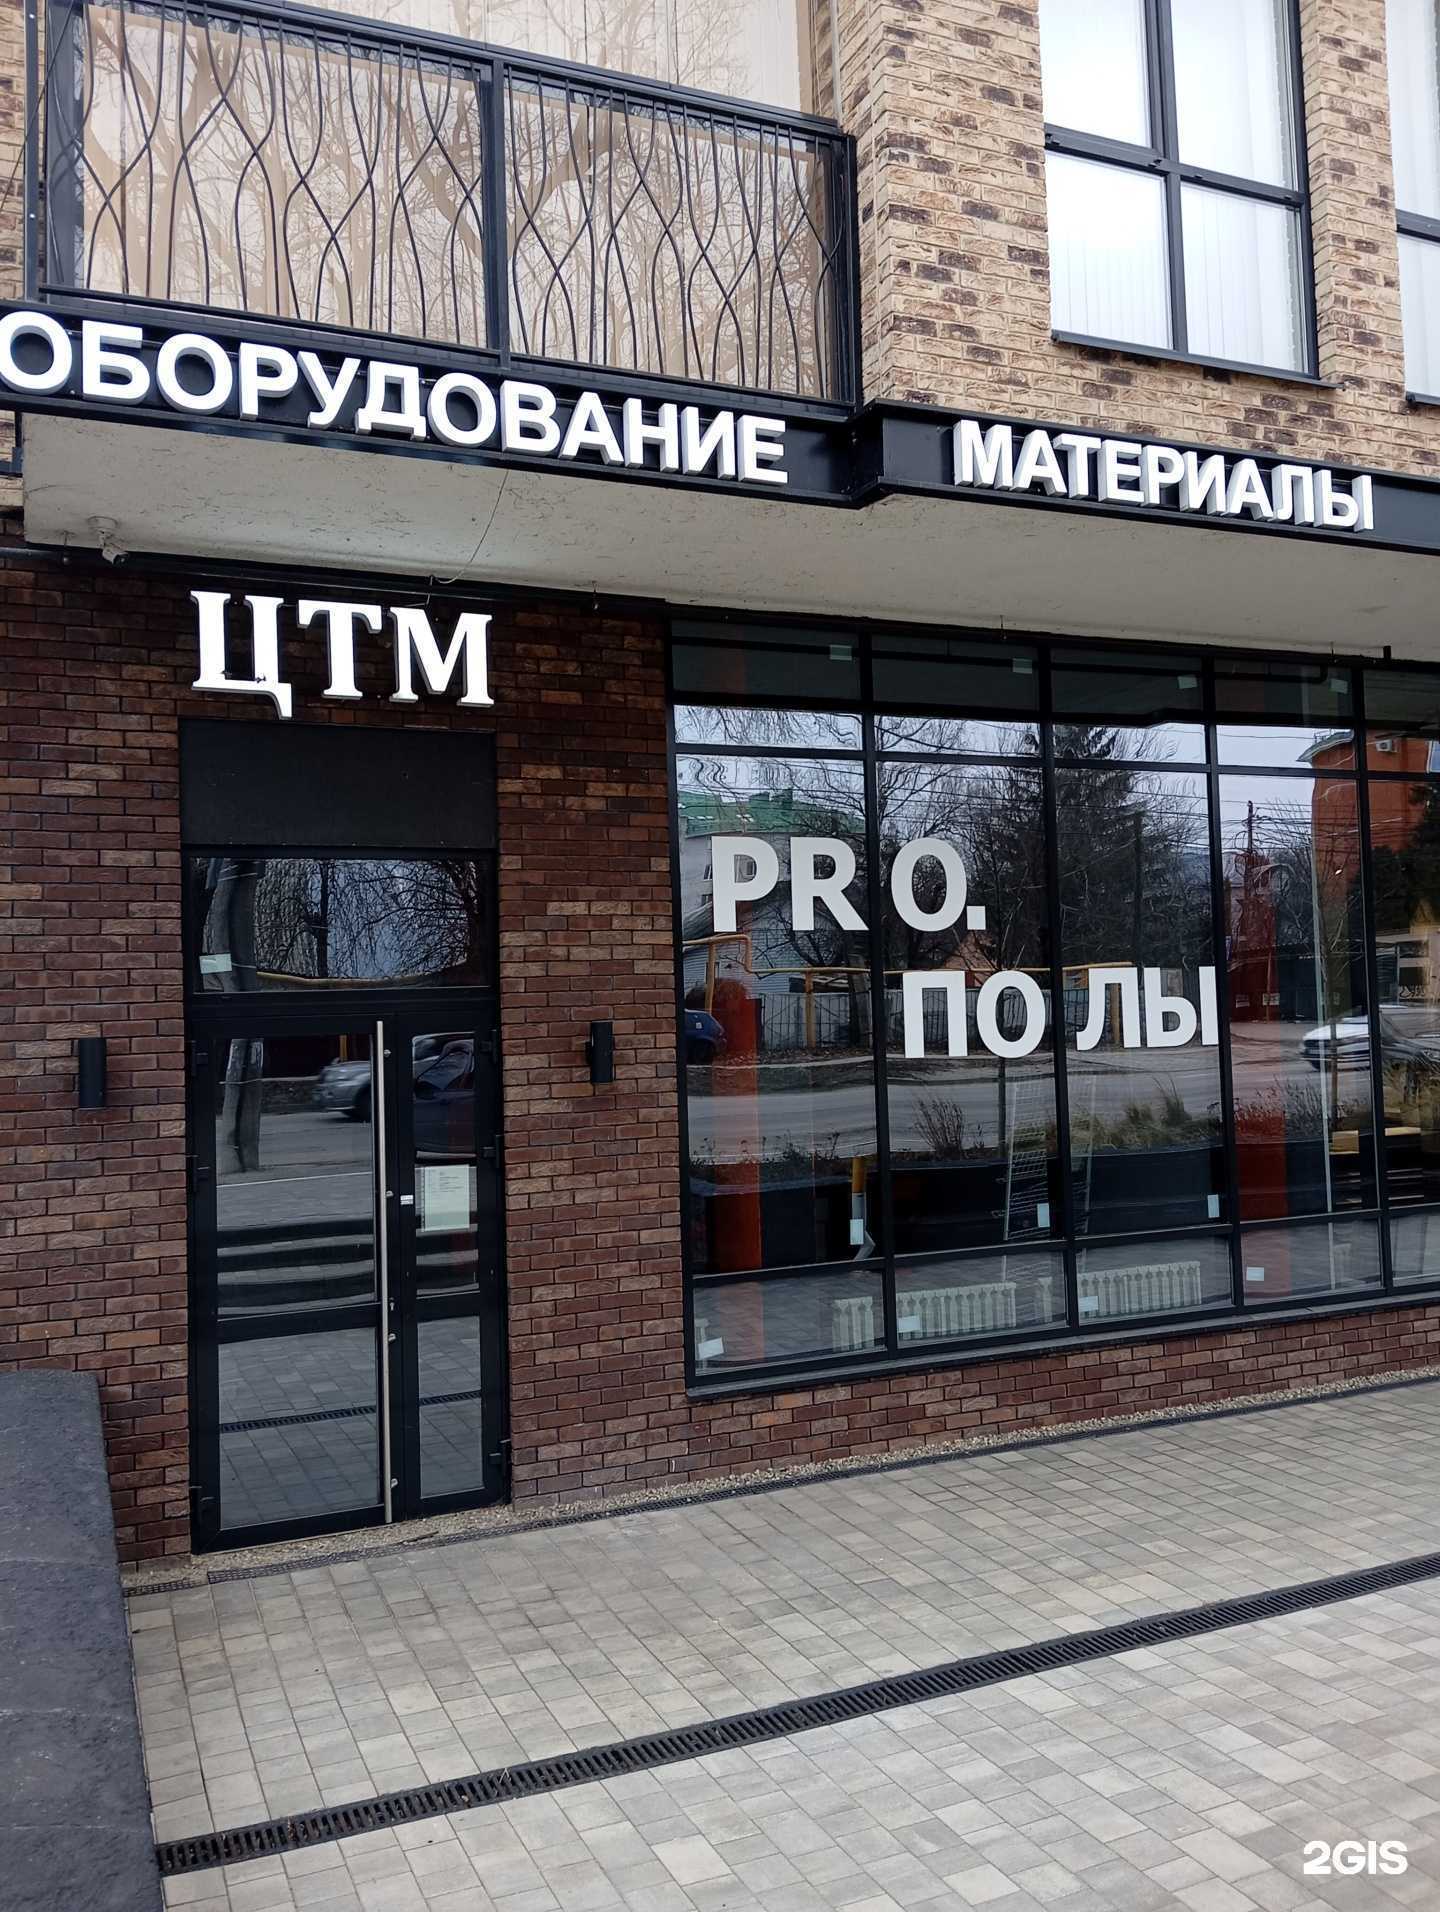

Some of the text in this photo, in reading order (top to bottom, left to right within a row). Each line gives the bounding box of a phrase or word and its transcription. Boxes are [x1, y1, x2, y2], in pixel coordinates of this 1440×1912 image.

[0, 311, 788, 484] ОБОРУДОВАНИЕ
[953, 420, 1374, 532] МАТЕРИАЛЫ
[190, 591, 495, 718] ЦТМ
[711, 836, 986, 933] PRO.
[903, 966, 1219, 1058] ПОЛЫ
